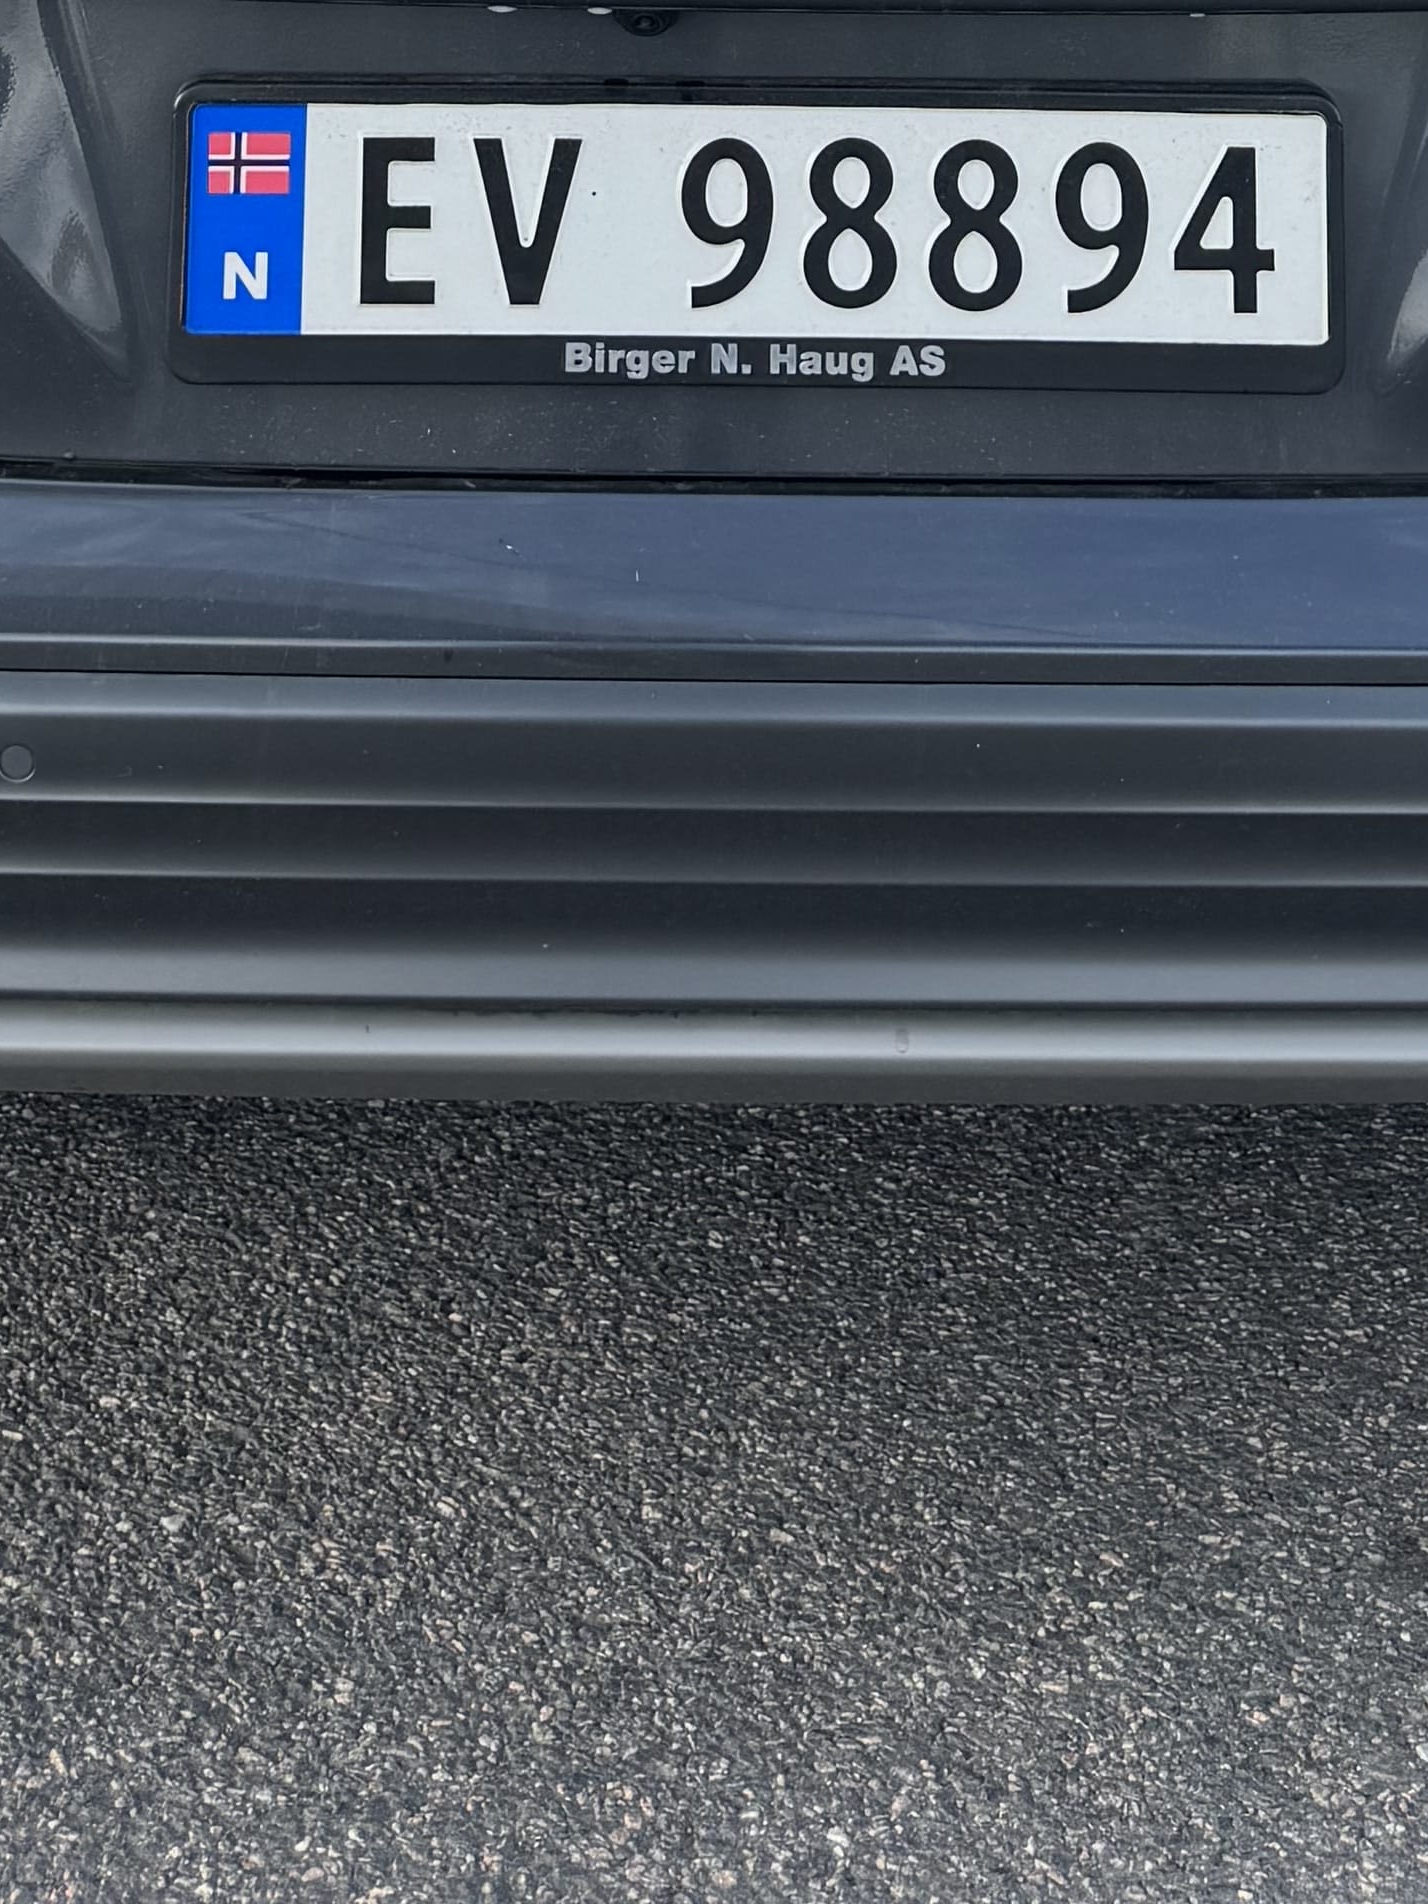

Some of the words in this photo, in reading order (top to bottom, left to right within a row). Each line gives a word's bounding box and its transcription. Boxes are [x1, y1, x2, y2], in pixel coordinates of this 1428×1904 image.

[358, 135, 583, 307] EV
[680, 136, 1276, 314] 98894
[222, 251, 270, 300] N
[565, 341, 695, 379] Birger
[710, 342, 753, 375] N.
[769, 343, 874, 382] Haug
[889, 345, 946, 377] AS
